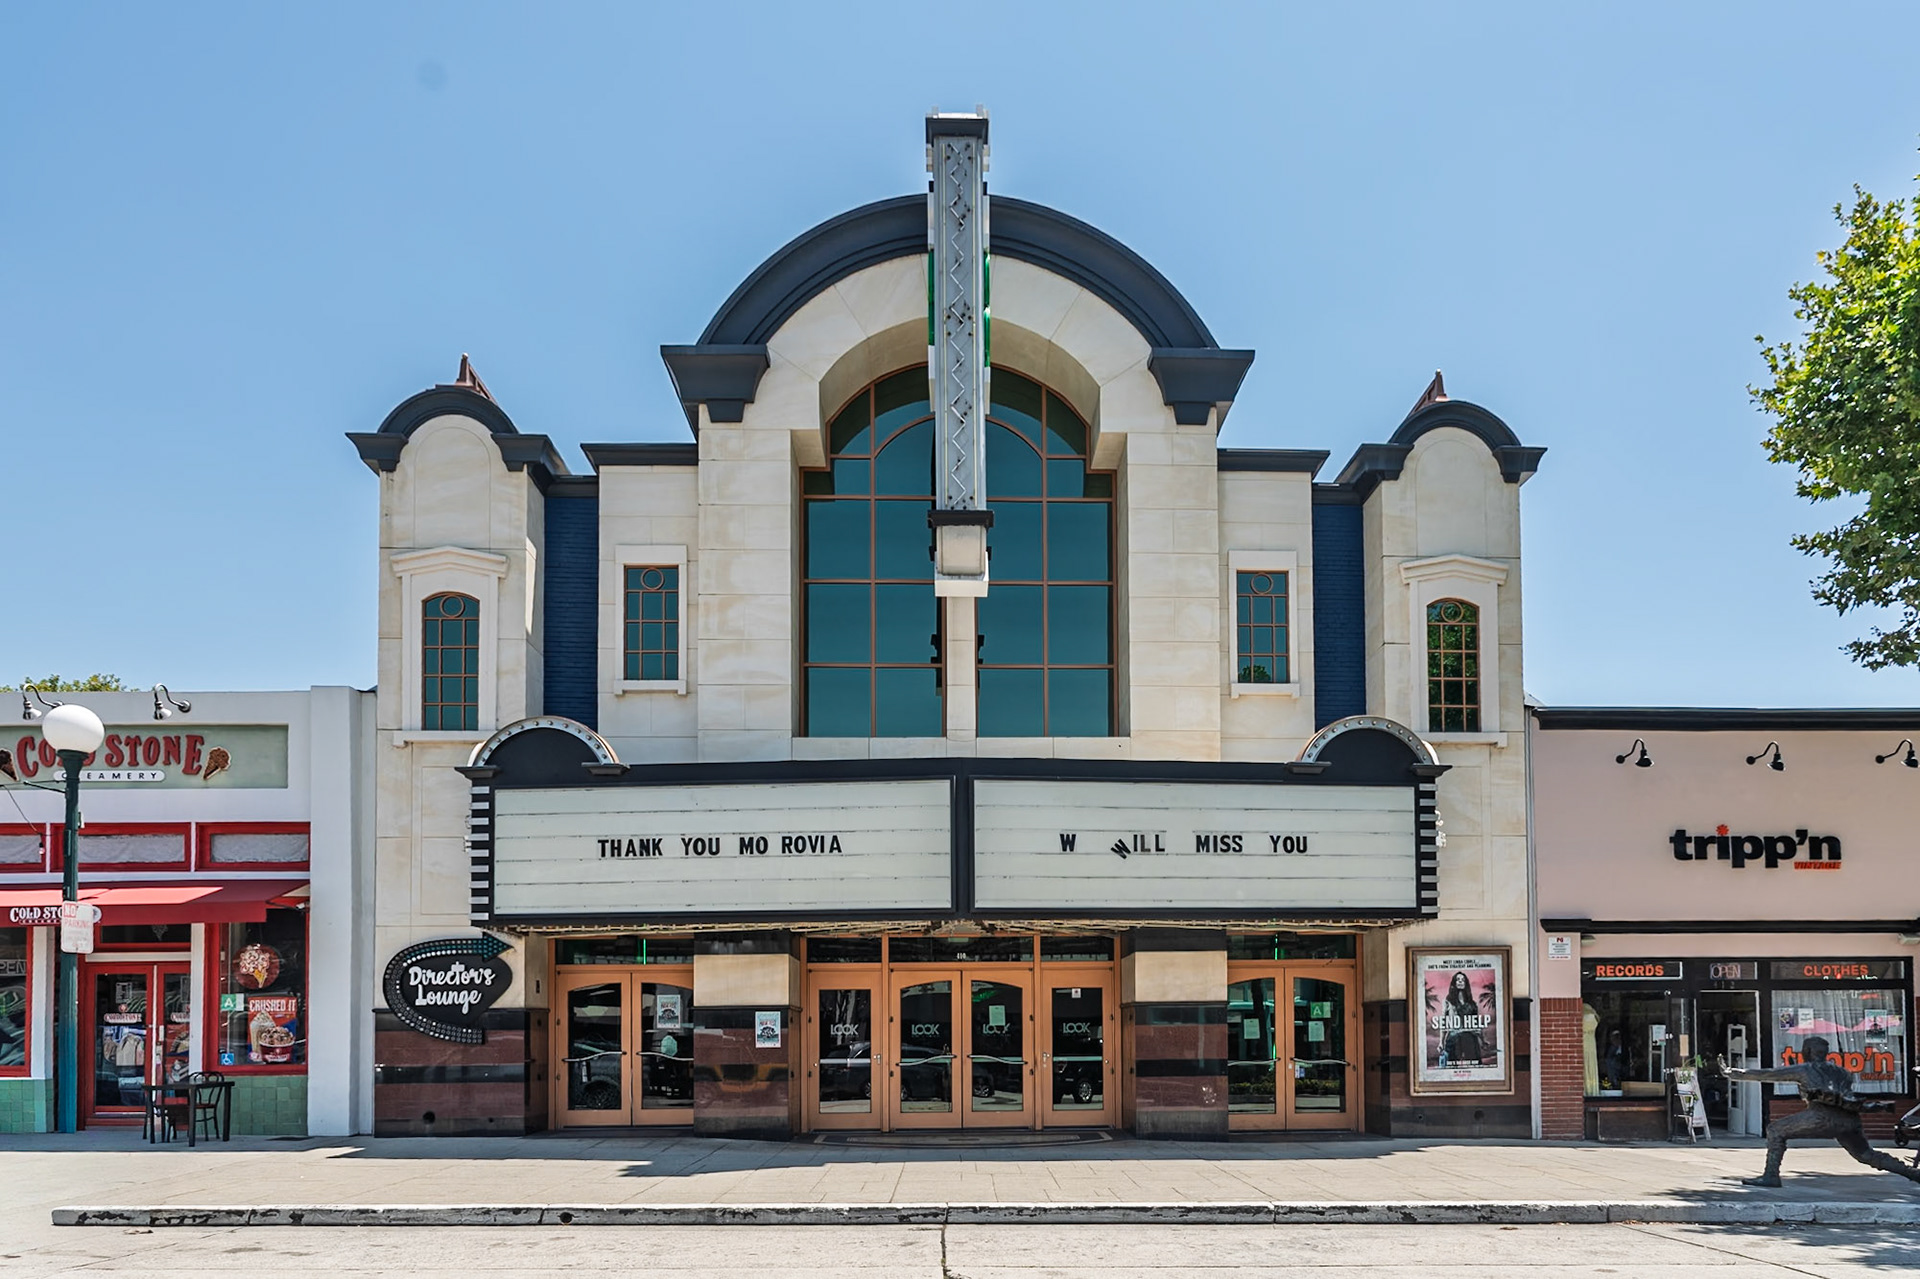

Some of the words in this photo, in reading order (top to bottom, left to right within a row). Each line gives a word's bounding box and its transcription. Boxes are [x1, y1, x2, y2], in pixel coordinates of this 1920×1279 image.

[17, 736, 96, 778] CO
[104, 734, 204, 775] STONE
[61, 772, 157, 780] CEAMERY
[597, 837, 663, 858] THANK
[680, 837, 721, 856] YOU
[739, 836, 769, 855] MO
[1059, 833, 1077, 852] W
[1110, 834, 1166, 860] WILL
[1195, 834, 1243, 853] MISS
[1269, 834, 1309, 854] YOU
[1669, 824, 1842, 869] tripp'n
[10, 906, 41, 922] COLD
[43, 906, 62, 919] STO
[64, 903, 76, 917] NO
[0, 961, 26, 975] PEN
[408, 960, 496, 986] Director's
[1595, 964, 1665, 977] RECORDS
[1711, 964, 1741, 978] OPEN
[1803, 964, 1869, 977] CLOTHES
[224, 997, 234, 1008] A
[249, 999, 286, 1012] CRUSHED
[288, 999, 297, 1012] IT
[414, 983, 482, 1015] Lounge
[1312, 1005, 1322, 1016] A
[1062, 1022, 1091, 1034] LOOK
[1431, 1015, 1460, 1030] SEND
[1463, 1014, 1491, 1029] HELP
[830, 1023, 859, 1036] LOOK
[911, 1023, 940, 1036] LOOK
